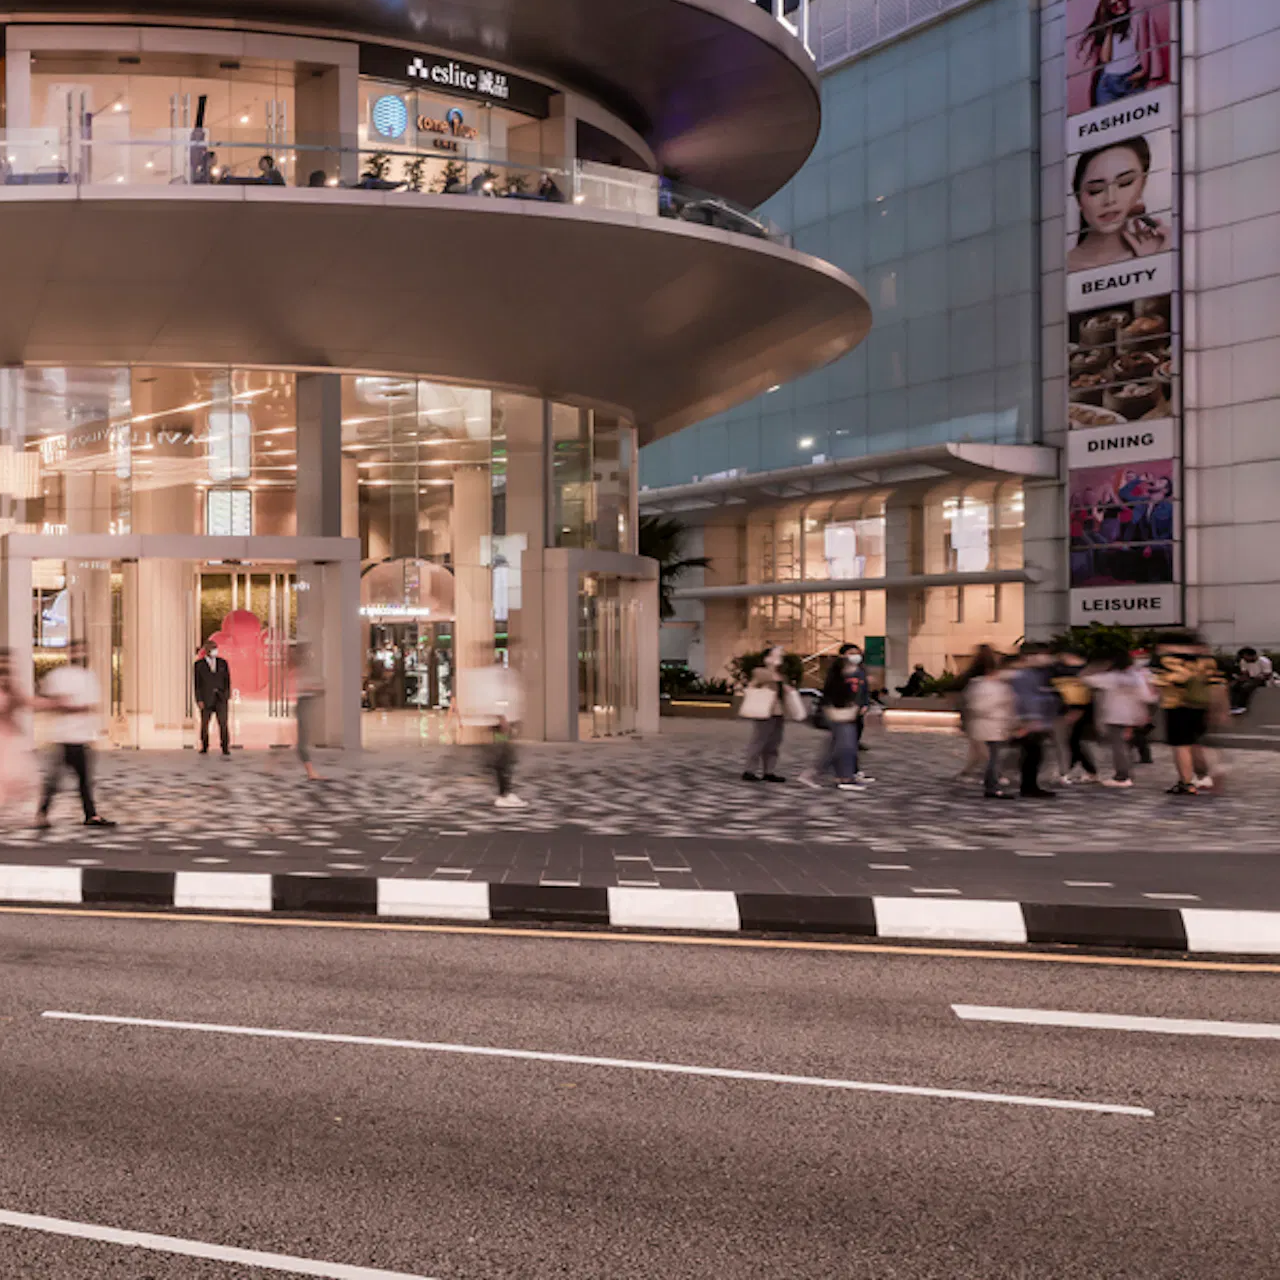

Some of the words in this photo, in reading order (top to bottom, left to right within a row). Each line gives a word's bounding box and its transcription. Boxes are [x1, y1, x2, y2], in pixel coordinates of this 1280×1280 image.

[431, 62, 477, 90] eslite
[1078, 103, 1162, 137] FASHION
[1081, 266, 1158, 295] BEAUTY
[1087, 433, 1155, 453] DINING
[1082, 595, 1162, 613] LEISURE
